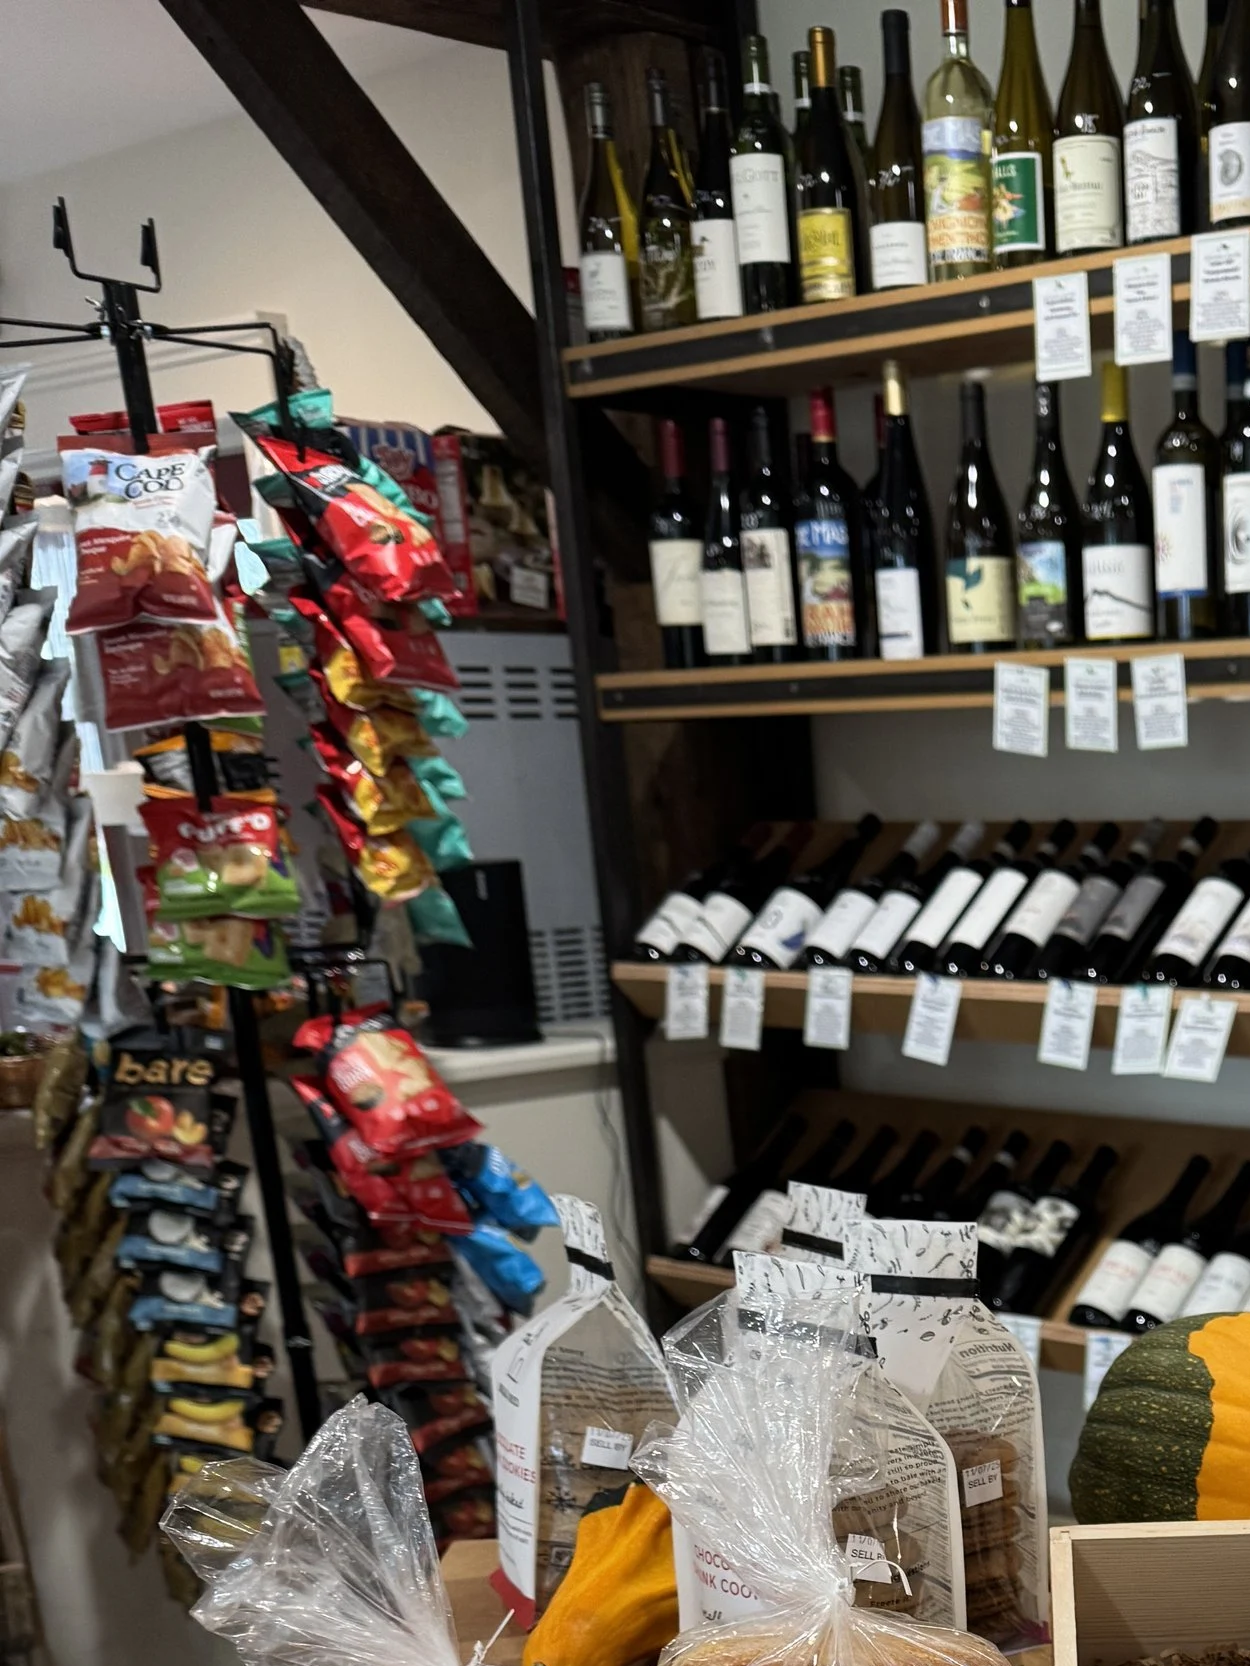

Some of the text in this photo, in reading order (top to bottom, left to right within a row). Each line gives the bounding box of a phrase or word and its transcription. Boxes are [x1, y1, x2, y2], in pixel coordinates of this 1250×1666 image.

[115, 462, 186, 482] CAPE
[125, 478, 184, 499] COD
[114, 1053, 214, 1086] bare
[968, 1473, 998, 1489] SELL BY
[851, 1548, 875, 1561] SELL
